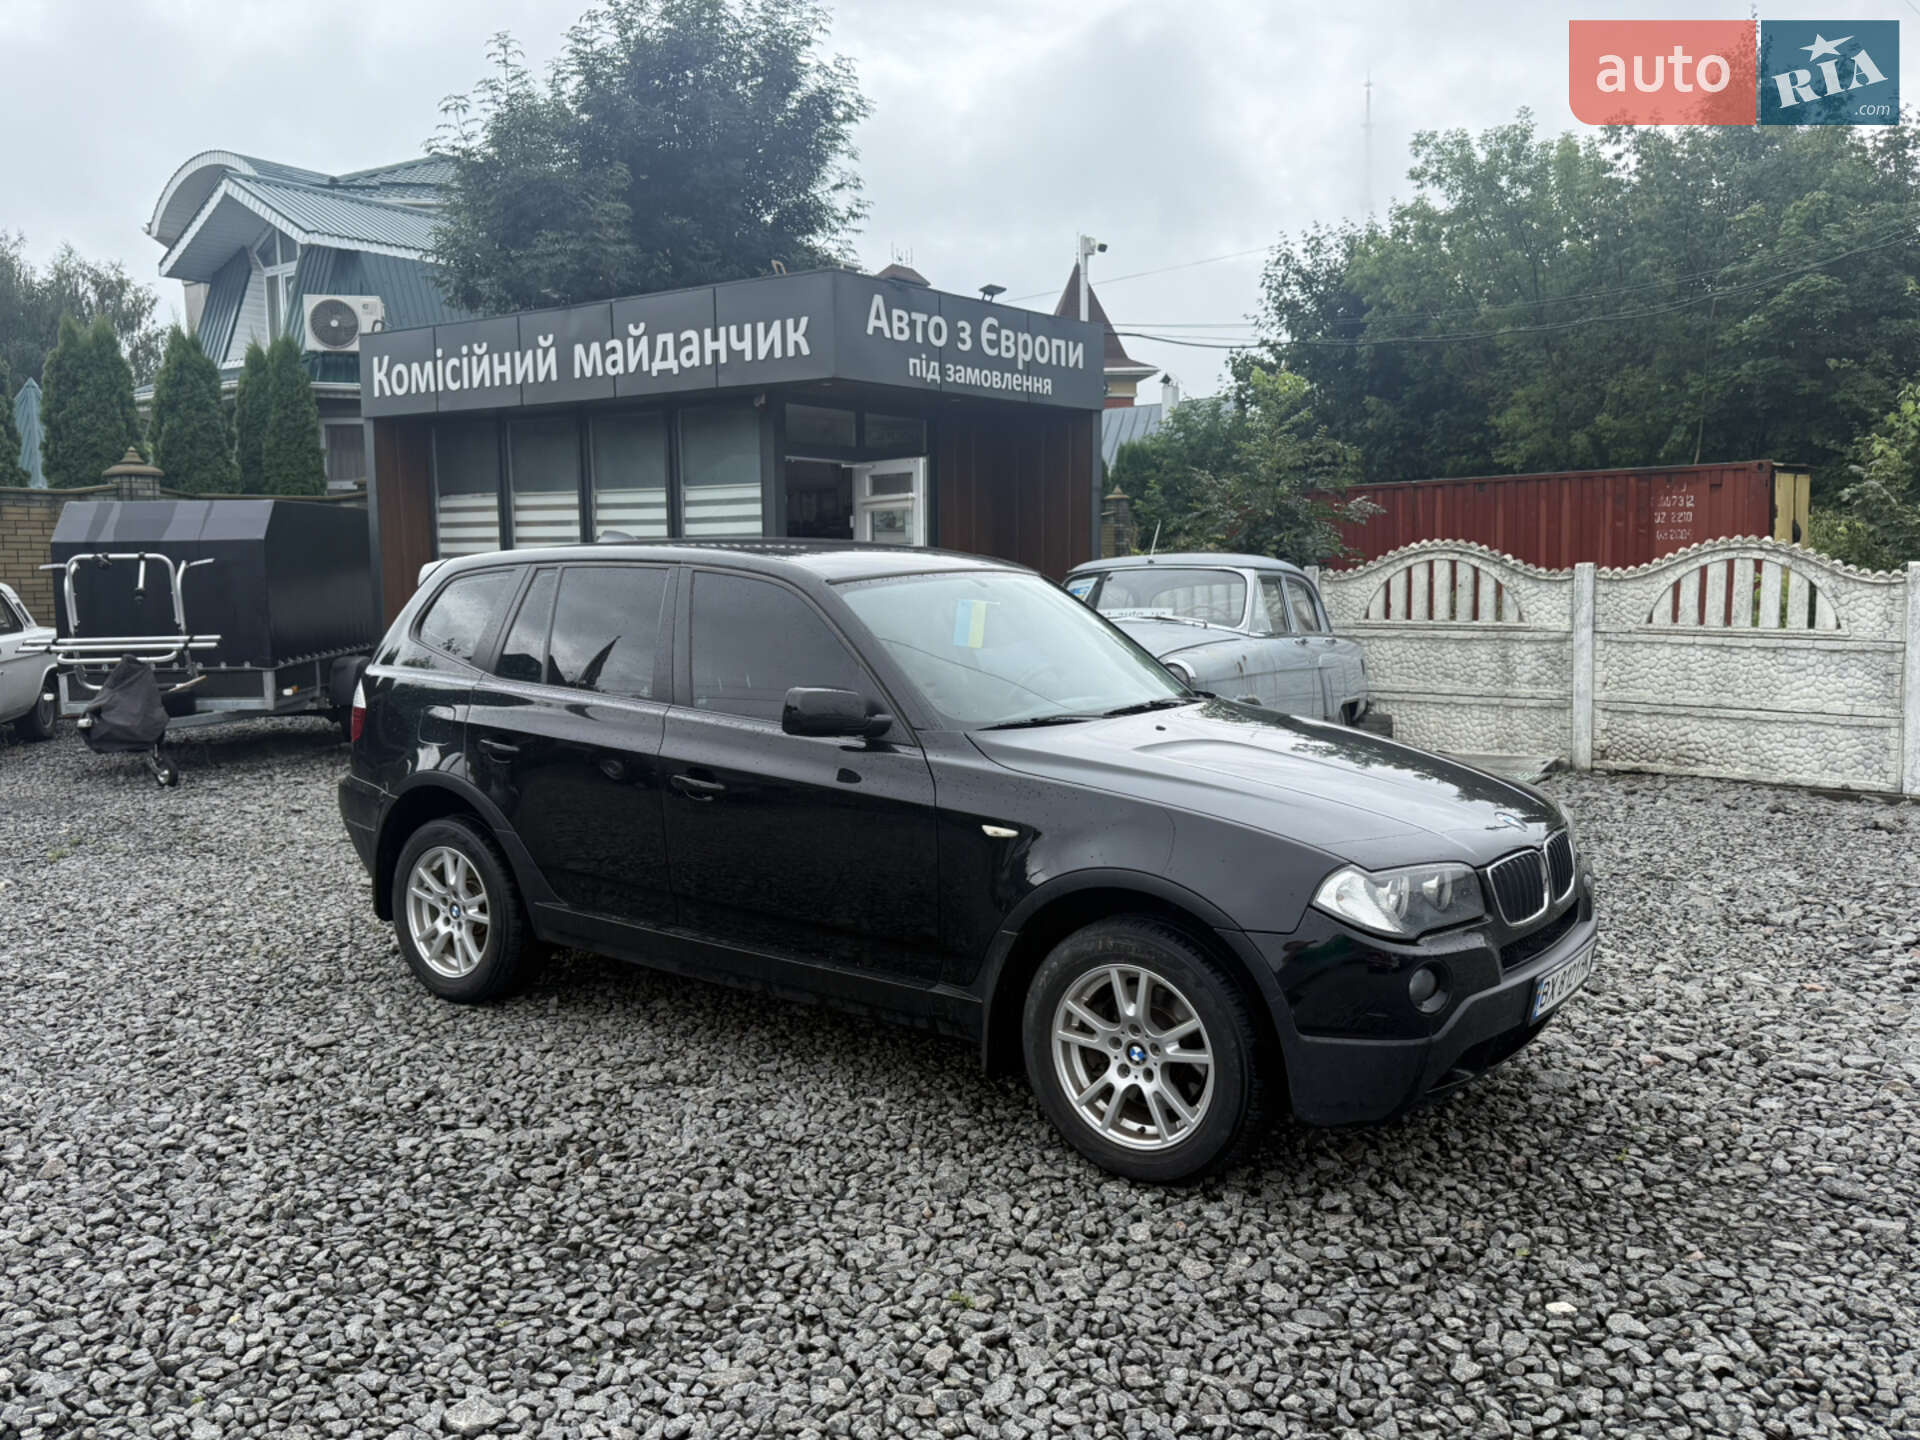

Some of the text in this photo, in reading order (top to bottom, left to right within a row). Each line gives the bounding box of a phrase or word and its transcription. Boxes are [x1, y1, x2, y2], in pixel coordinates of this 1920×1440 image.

[372, 316, 811, 398] Комісійний майданчик
[866, 294, 1084, 370] Авто з Європи
[908, 353, 1052, 395] під замовлення
